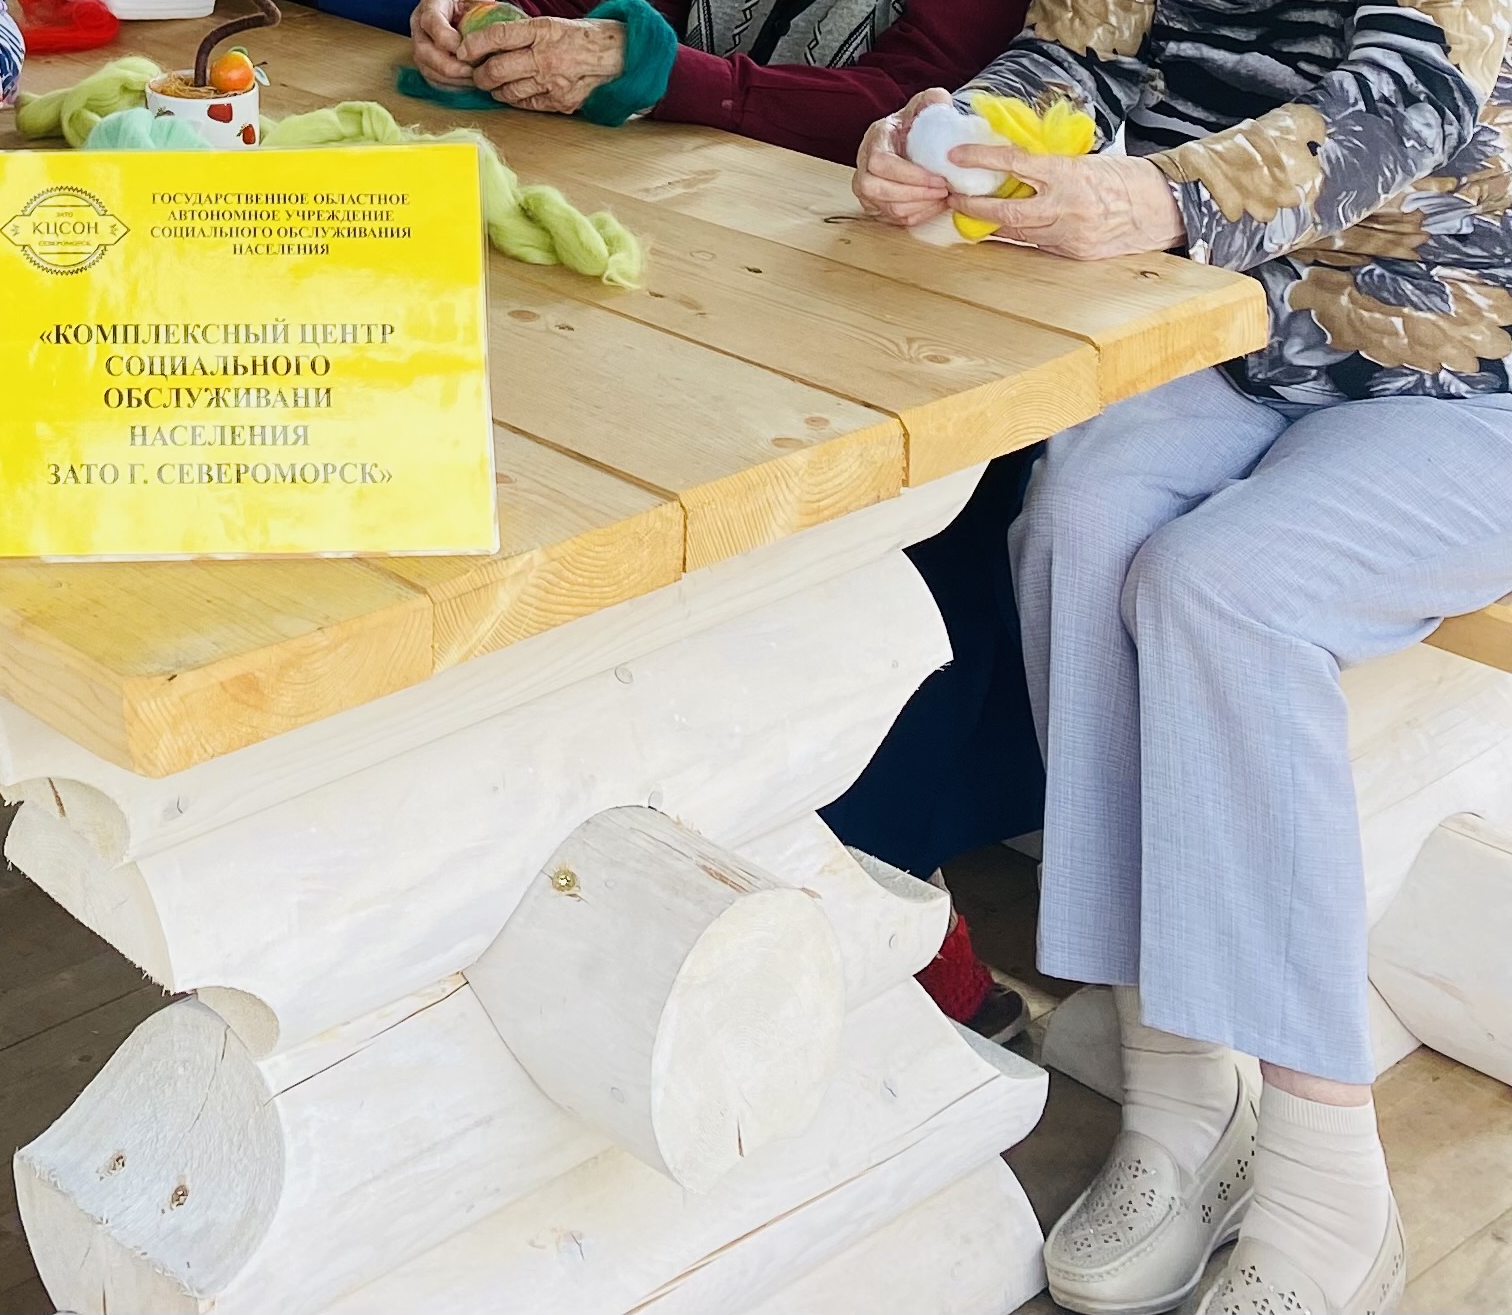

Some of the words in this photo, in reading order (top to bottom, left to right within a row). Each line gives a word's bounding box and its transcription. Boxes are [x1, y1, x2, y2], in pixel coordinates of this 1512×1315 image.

[151, 192, 309, 206] ГОСУДАРСТВЕННОЕ
[313, 192, 410, 206] ОБЛАСТНОЕ
[167, 209, 281, 222] АВТОНОМНОЕ
[285, 209, 395, 223] УЧРЕЖДЕНИЕ
[32, 221, 99, 238] КЦСОН
[150, 225, 273, 240] СОЦИАЛЬНОГО
[276, 225, 412, 240] ОБСЛУЖИВАНИЯ
[232, 242, 331, 256] НАСЕЛЕНИЯ
[38, 317, 291, 346] «КОМПЛЕКСНЫЙ
[298, 322, 397, 349] ЦЕНТР
[104, 354, 332, 381] СОЦИАЛЬНОГО
[103, 386, 333, 409] ОБСЛУЖИВАНИ
[128, 423, 311, 448] НАСЕЛЕНИЯ
[46, 462, 120, 485] ЗАТО
[127, 462, 149, 485] Г.
[155, 461, 394, 485] СЕВЕРОМОРСК»
